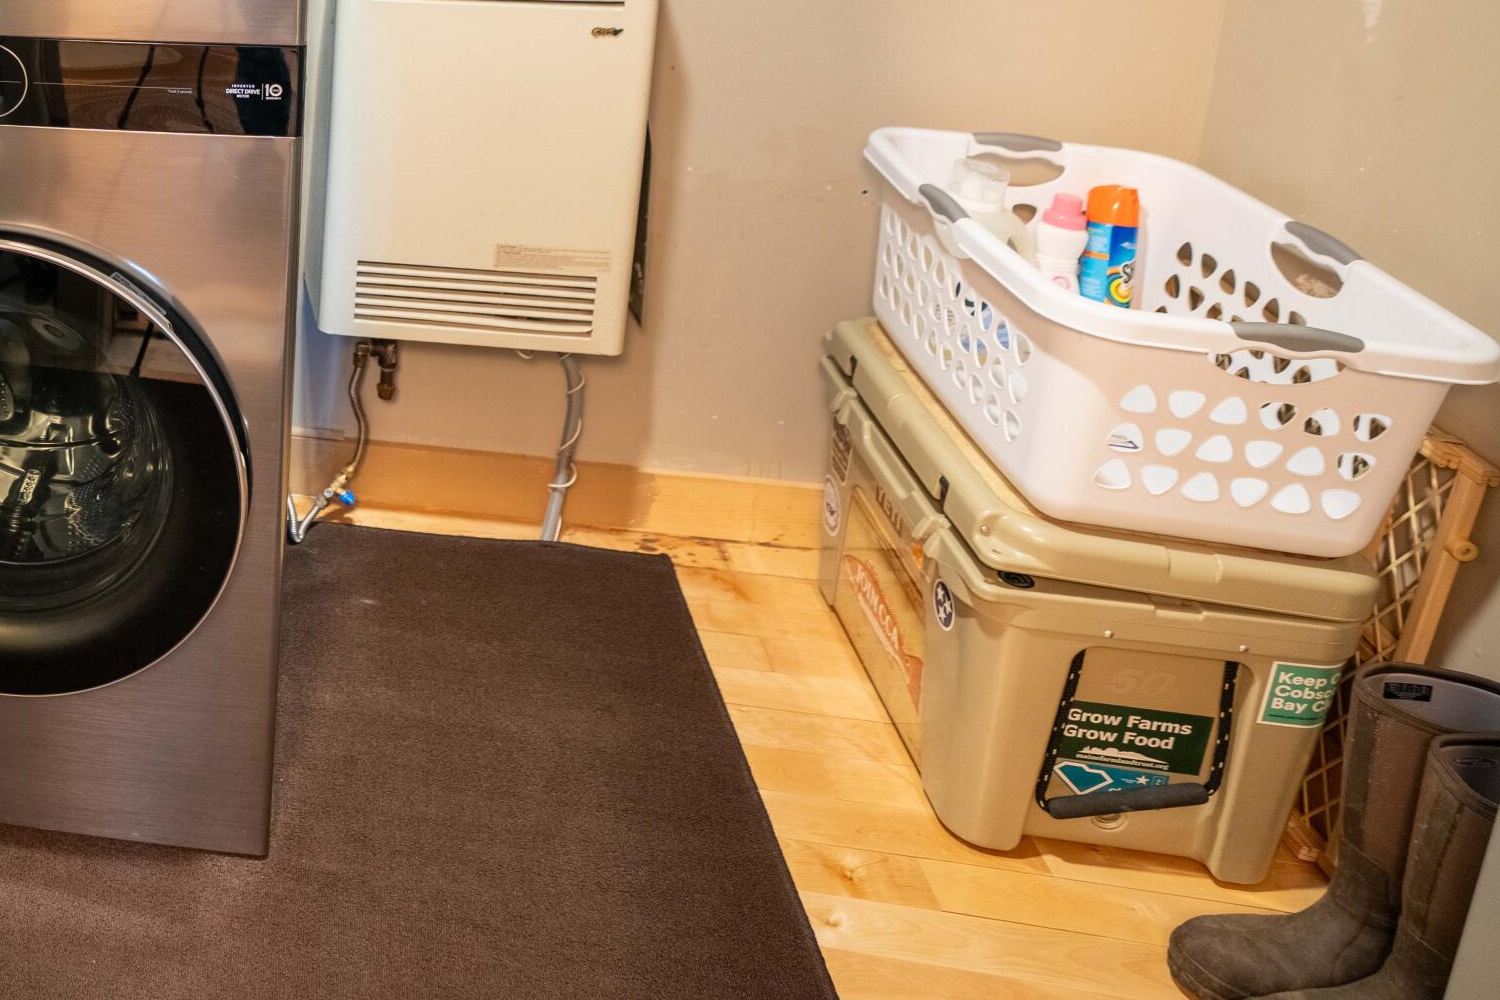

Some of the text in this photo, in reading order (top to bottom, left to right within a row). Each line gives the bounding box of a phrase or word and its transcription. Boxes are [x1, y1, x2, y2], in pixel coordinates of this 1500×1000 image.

[1278, 671, 1327, 689] Keep
[1271, 697, 1308, 714] Bay
[1067, 708, 1193, 736] Grow Farms
[1063, 724, 1175, 750] Grow Food
[1075, 752, 1170, 771] mainefarmlandtrust.org
